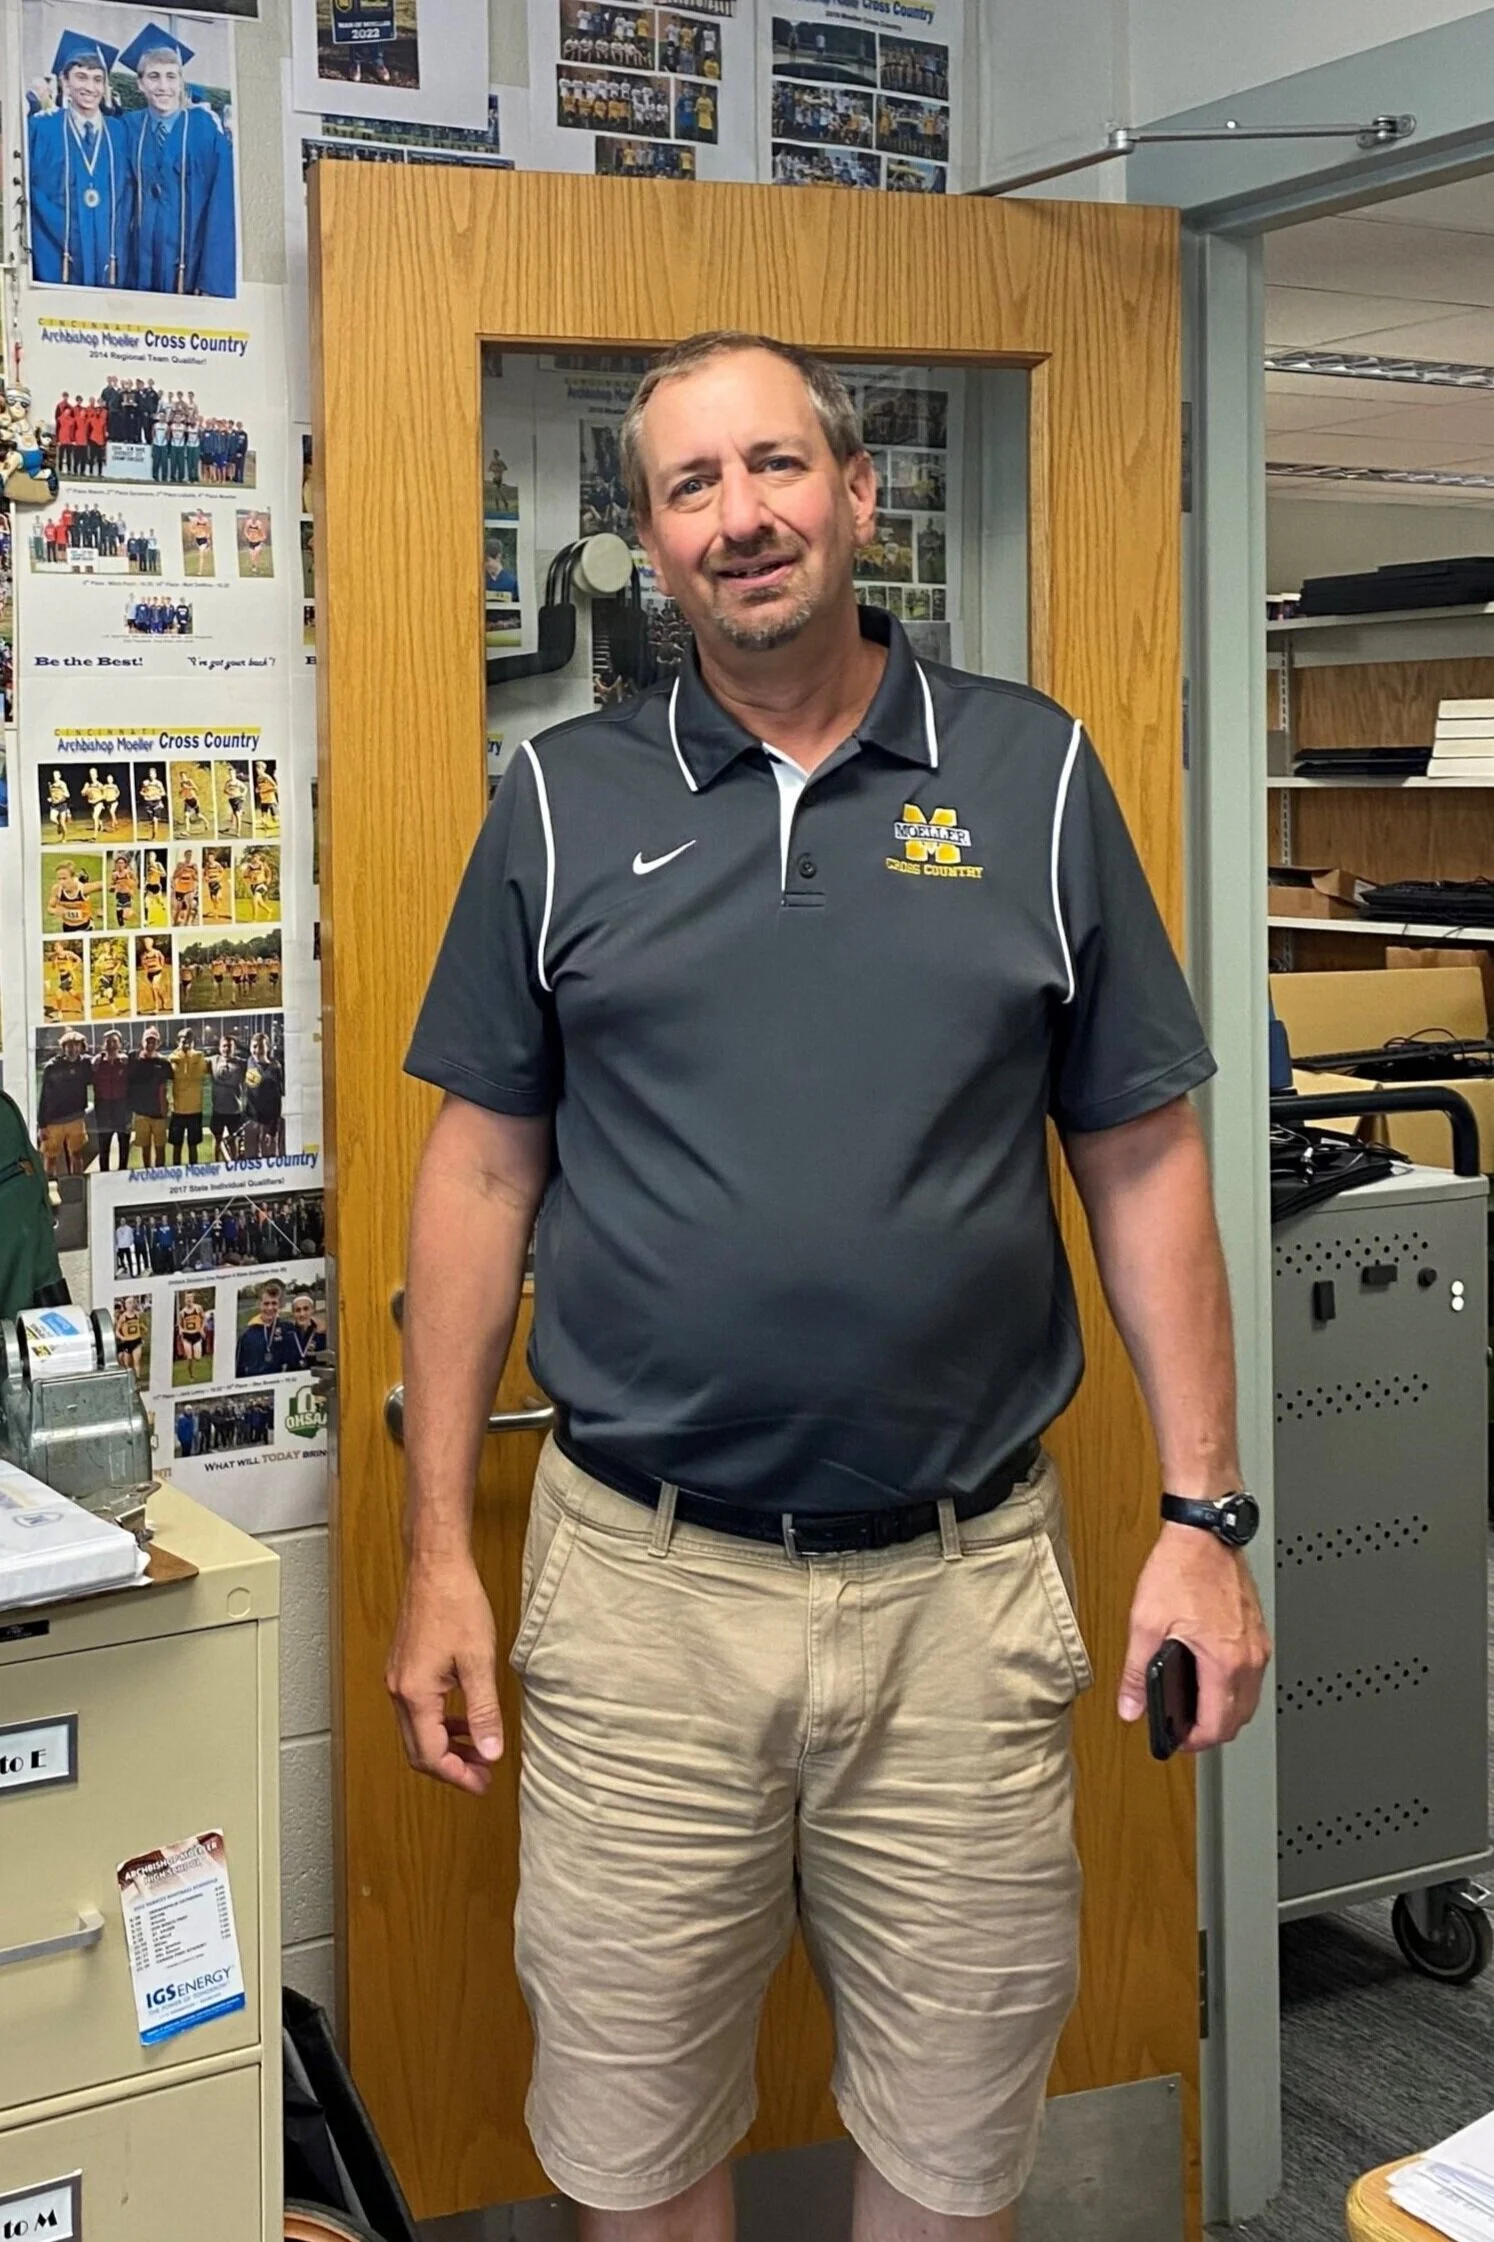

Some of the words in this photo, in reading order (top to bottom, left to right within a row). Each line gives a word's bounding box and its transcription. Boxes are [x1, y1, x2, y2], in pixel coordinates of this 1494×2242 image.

[893, 2, 935, 25] Country
[351, 28, 381, 40] 2022
[38, 318, 142, 331] CINCINNATI
[41, 327, 100, 348] Archbishop
[101, 331, 139, 348] Moeller
[144, 329, 187, 350] Cross
[190, 332, 248, 358] Country
[33, 656, 60, 667] Be
[63, 656, 93, 667] the
[96, 656, 143, 667] Best!
[54, 728, 156, 737] CINCINNATI
[57, 737, 115, 756] Archbishop
[116, 736, 154, 752] Moeller
[159, 731, 200, 749] Cross
[203, 731, 260, 752] Country
[886, 858, 921, 875] CROSS
[923, 864, 984, 879] COUNTRY
[128, 1166, 184, 1183] Archbishop
[185, 1160, 221, 1180] Moeller
[225, 1156, 263, 1172] Cross
[266, 1151, 320, 1170] Country
[169, 1185, 188, 1195] 2017
[210, 1180, 246, 1191] Individual
[204, 1461, 236, 1472] WHAT
[237, 1456, 261, 1467] WILL
[262, 1450, 301, 1463] TODAY
[302, 1449, 327, 1459] BRIN
[0, 1755, 24, 1775] to
[31, 1749, 47, 1769] E
[4, 2220, 29, 2240] to
[34, 2208, 58, 2232] M
